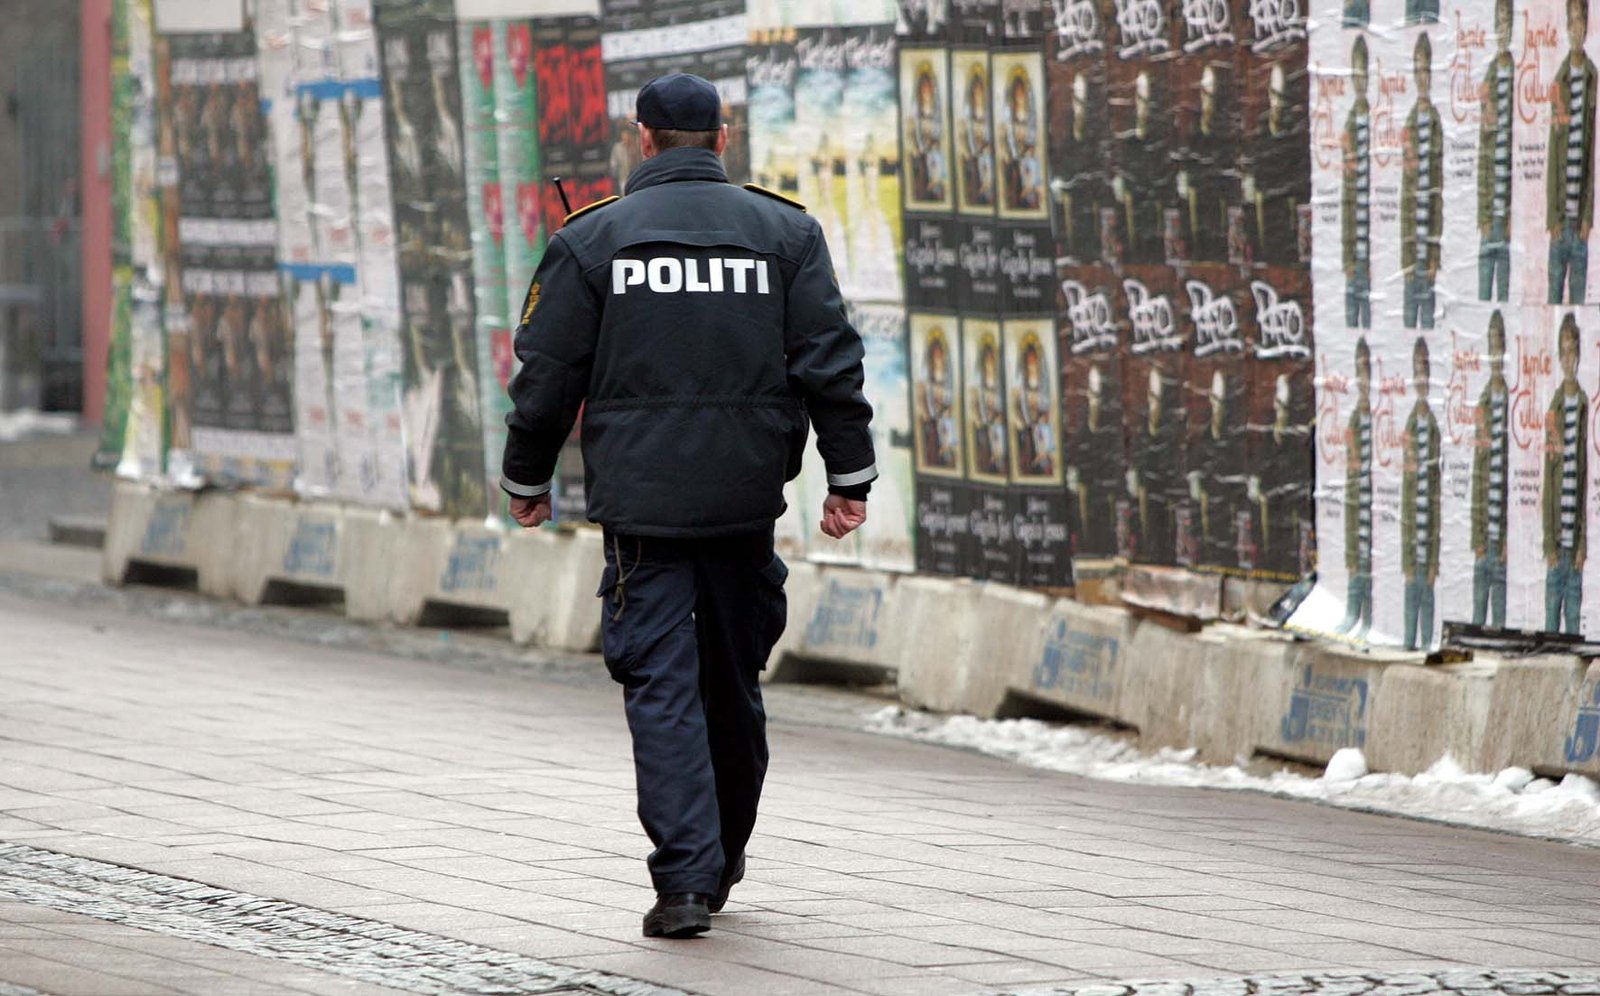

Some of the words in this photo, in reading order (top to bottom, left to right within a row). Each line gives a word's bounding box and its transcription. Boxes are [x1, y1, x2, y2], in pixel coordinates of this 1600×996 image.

[1516, 9, 1558, 68] Jamie
[612, 257, 770, 294] POLITI
[1509, 335, 1553, 394] Jamie
